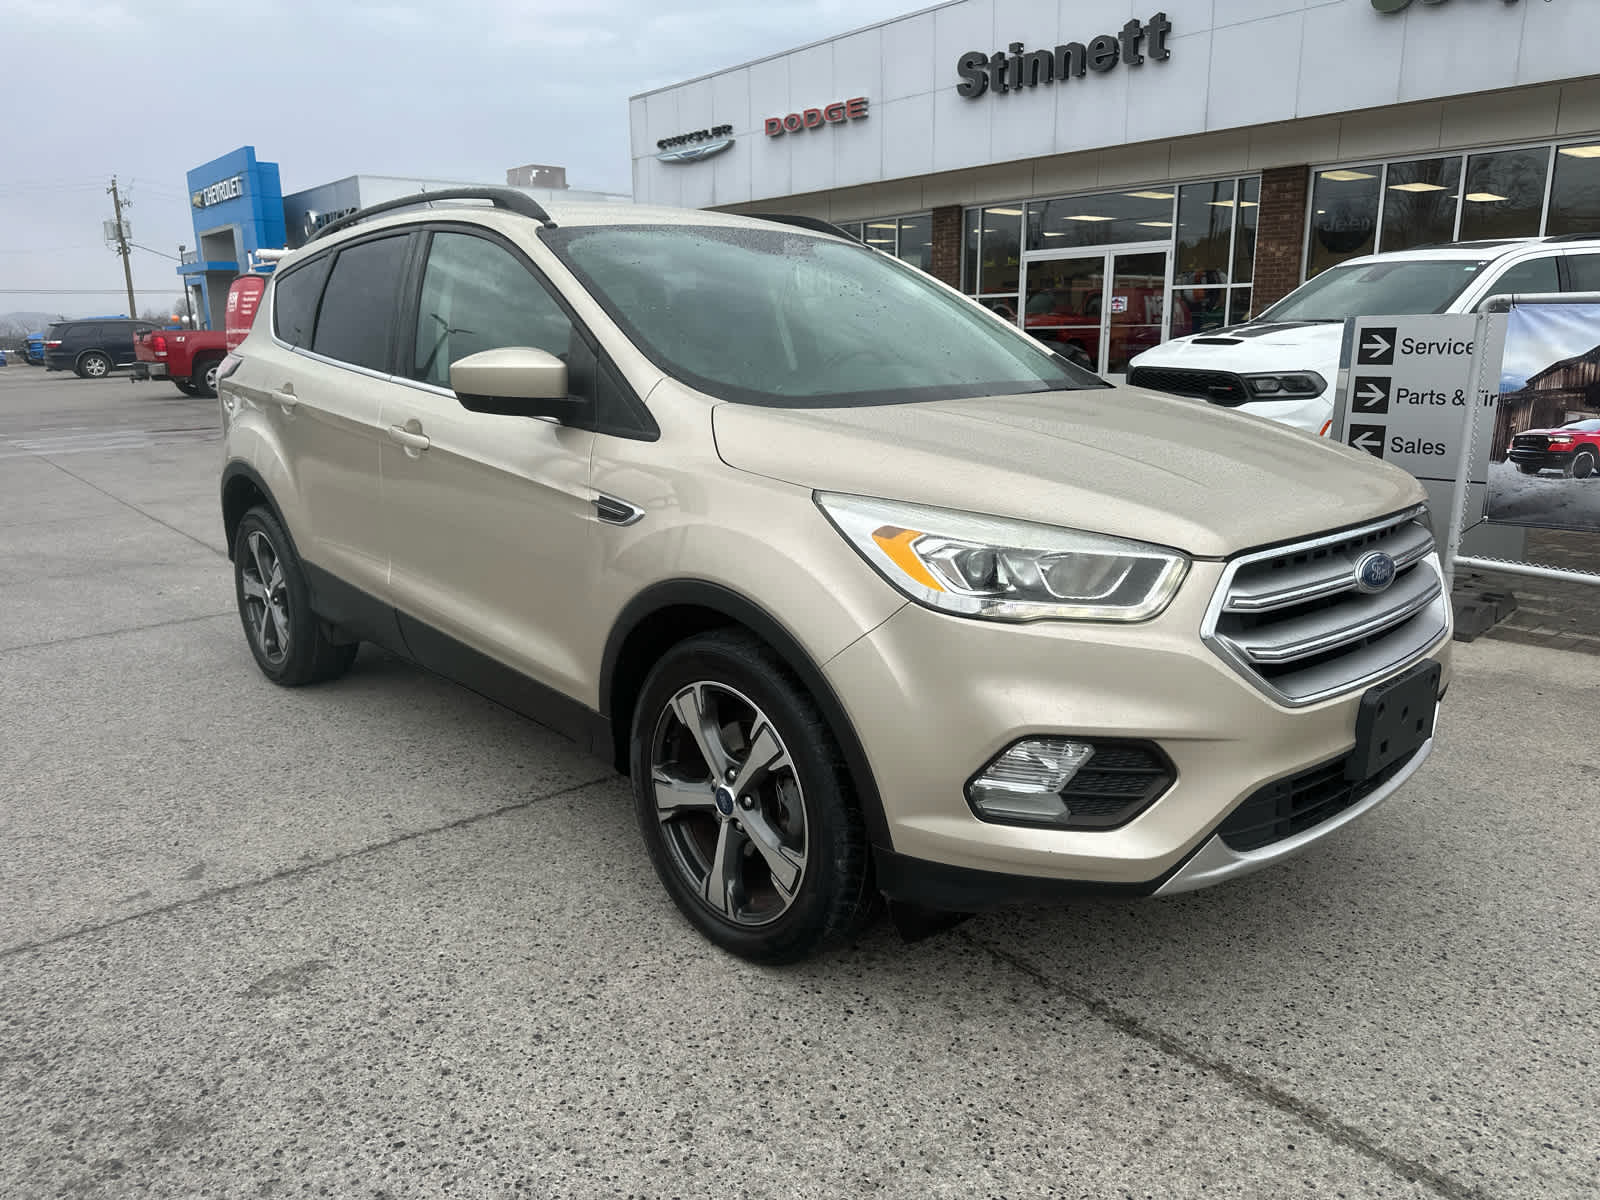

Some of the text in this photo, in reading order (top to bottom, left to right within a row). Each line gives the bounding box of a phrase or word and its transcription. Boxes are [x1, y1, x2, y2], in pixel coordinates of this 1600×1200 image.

[957, 12, 1172, 97] Stinnett
[765, 97, 869, 137] DODGE
[203, 176, 244, 206] CHEVROLET
[1401, 337, 1474, 355] Service
[1396, 387, 1446, 406] Parts
[1452, 389, 1465, 406] &
[1391, 436, 1446, 456] Sales
